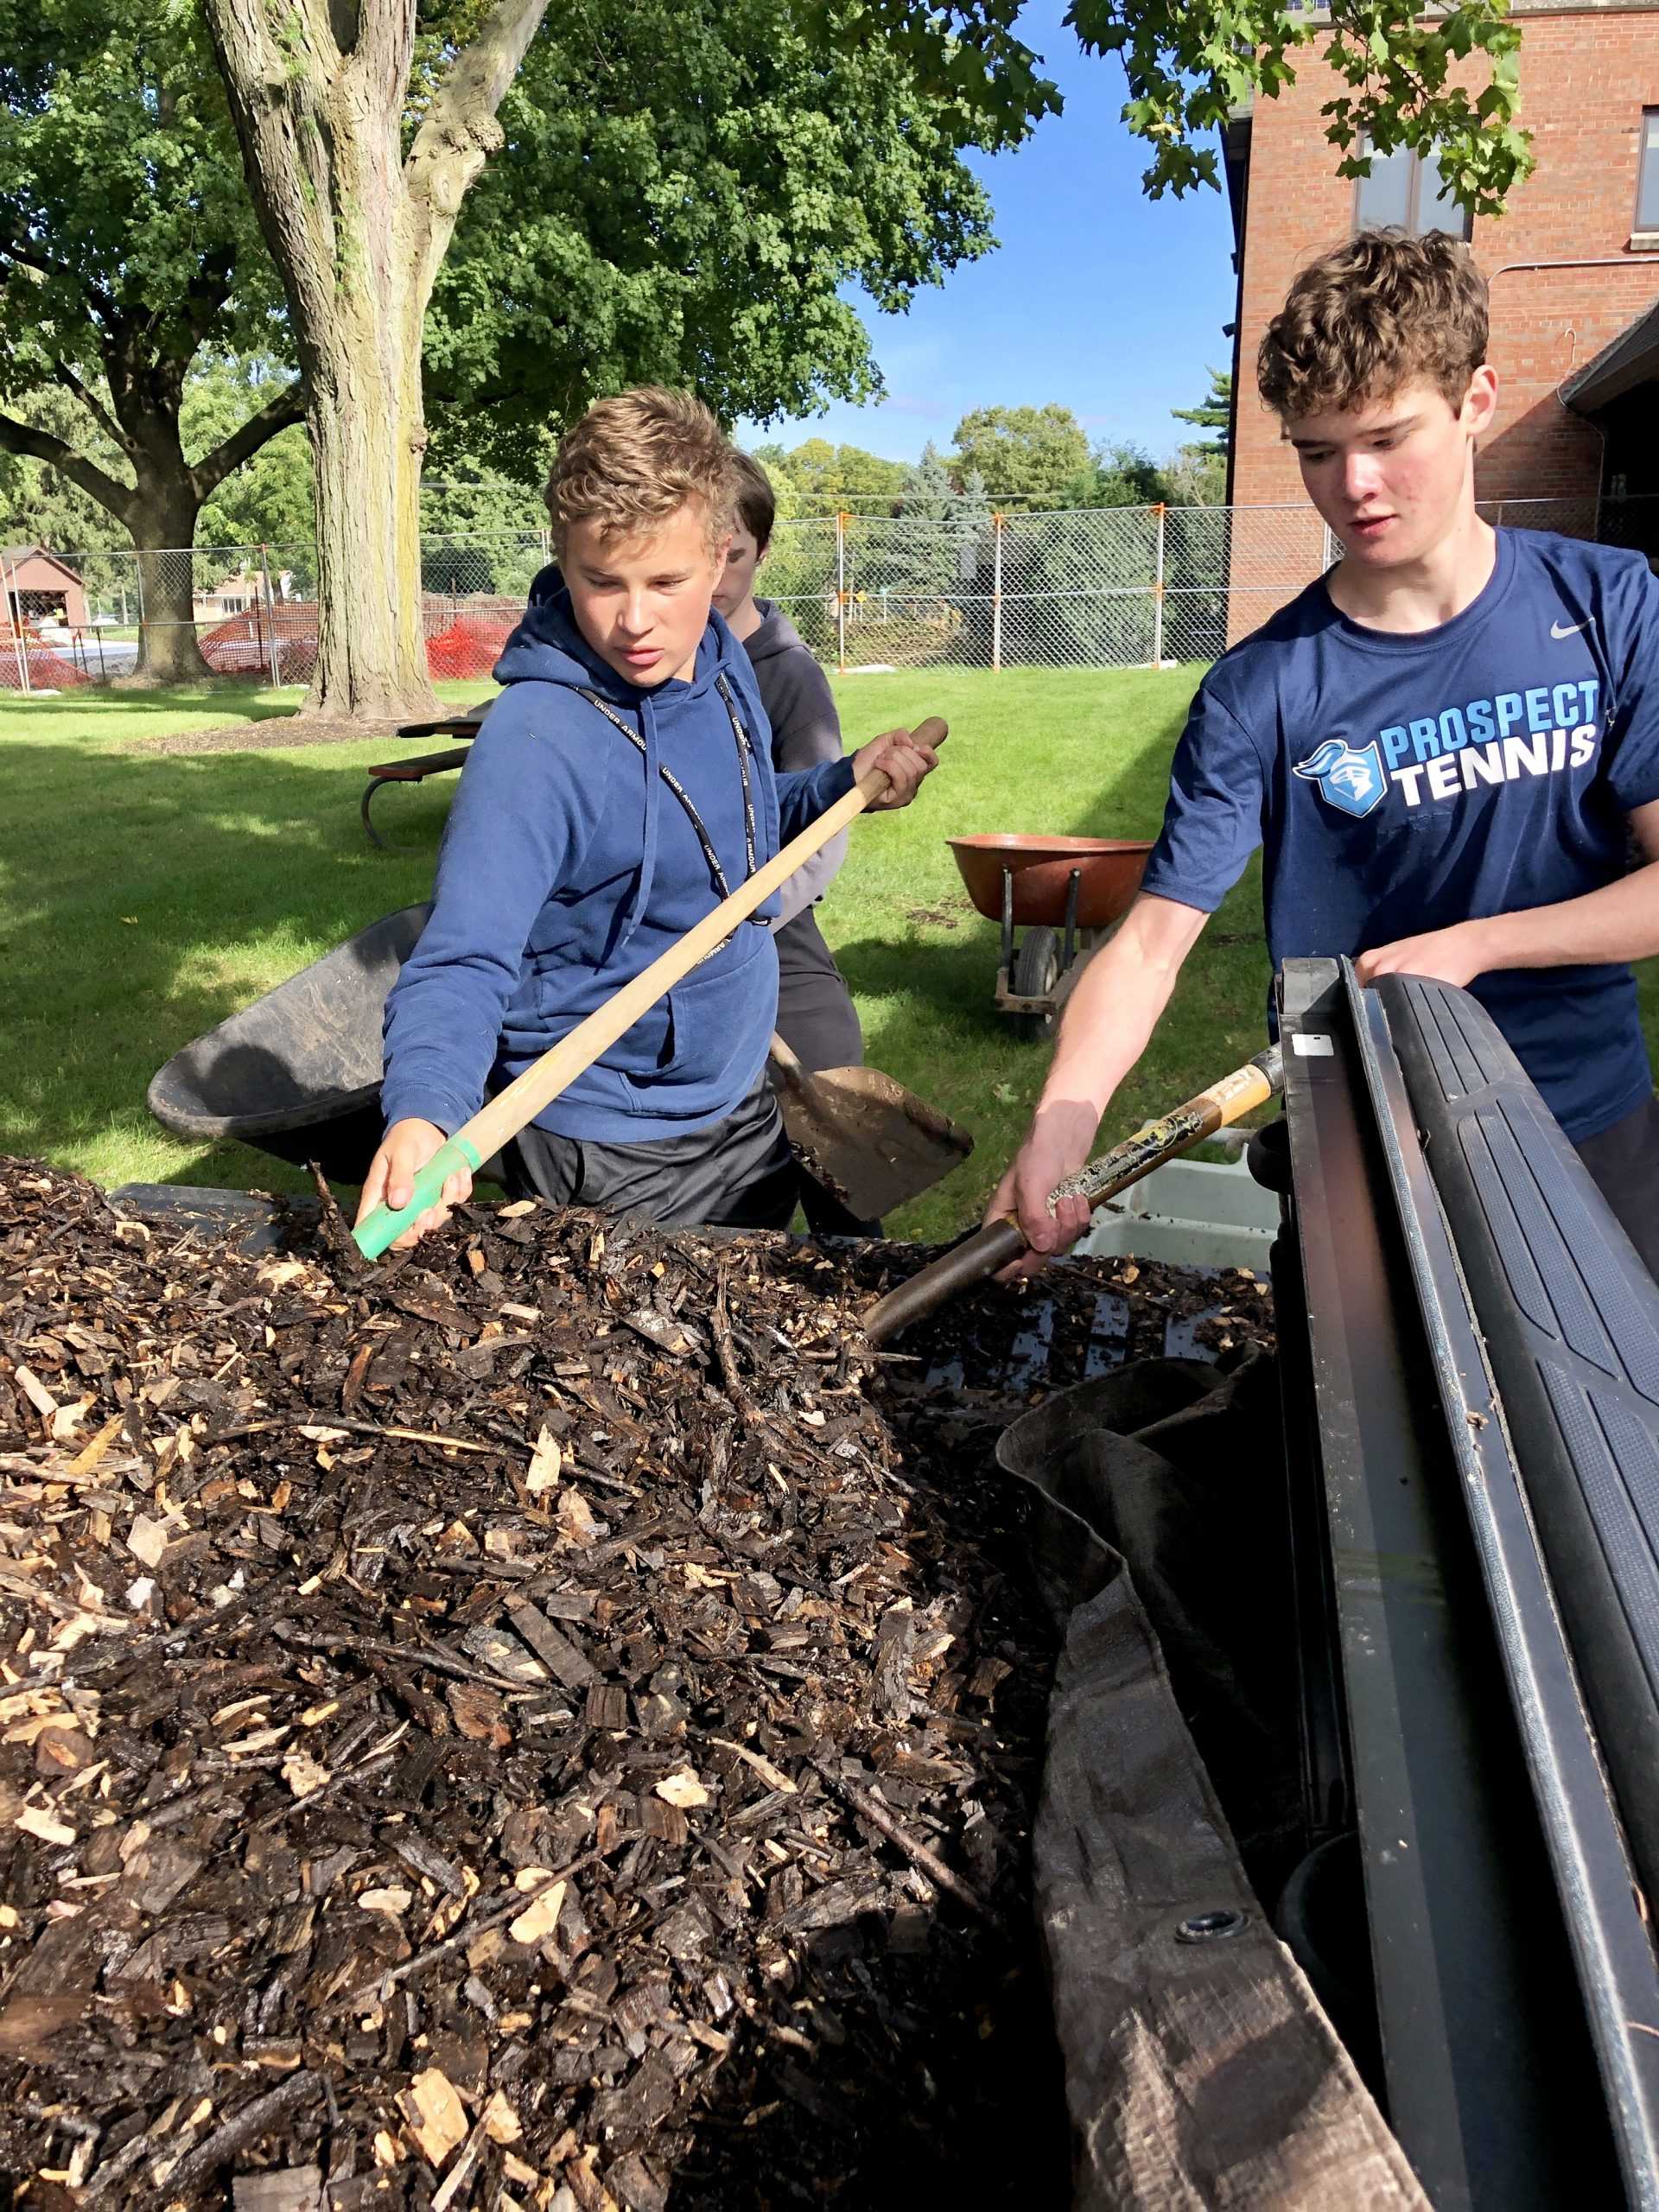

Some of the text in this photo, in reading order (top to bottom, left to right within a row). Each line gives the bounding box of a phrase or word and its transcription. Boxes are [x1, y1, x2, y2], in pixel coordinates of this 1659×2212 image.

[594, 699, 647, 751] UNDER ARMOU
[1380, 679, 1599, 770] PROSPECT
[662, 766, 683, 793] UNDER
[1390, 723, 1597, 807] TENNIS
[704, 844, 721, 870] UNDER
